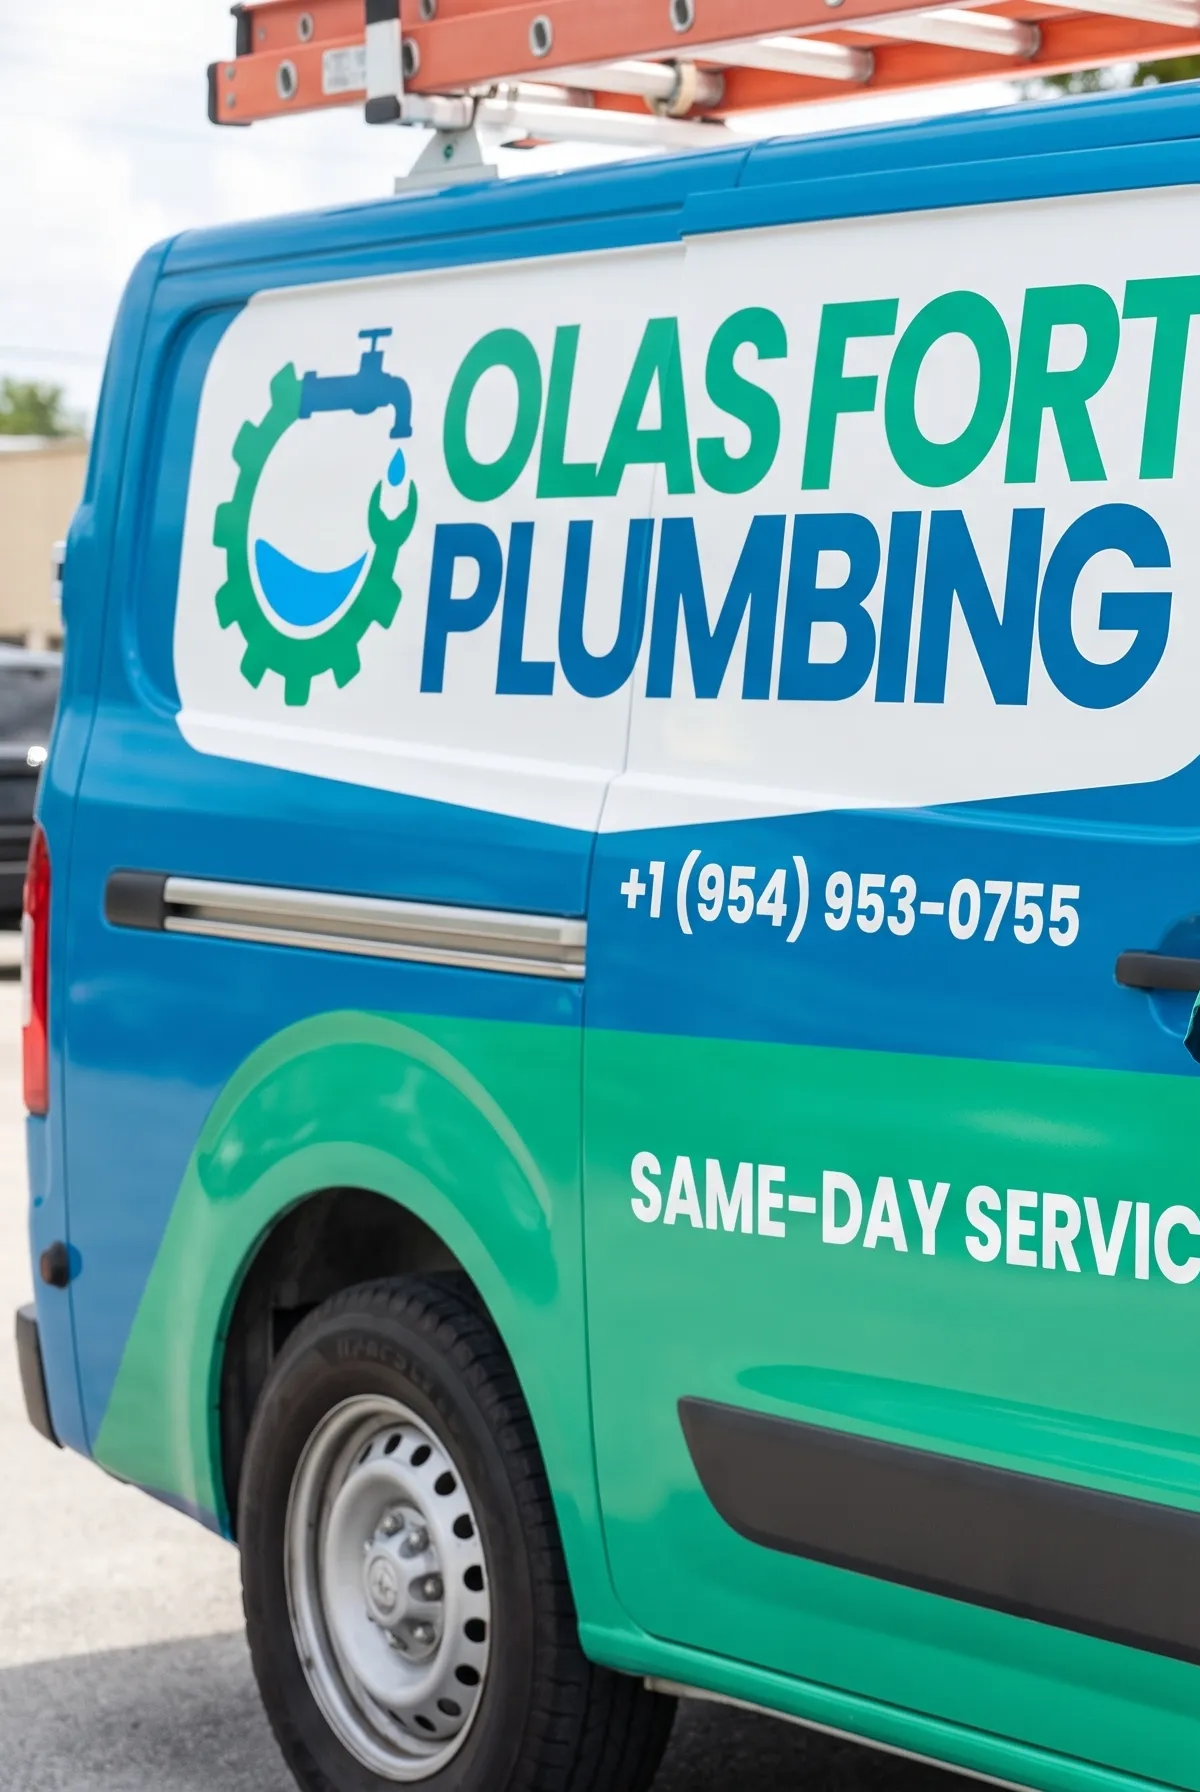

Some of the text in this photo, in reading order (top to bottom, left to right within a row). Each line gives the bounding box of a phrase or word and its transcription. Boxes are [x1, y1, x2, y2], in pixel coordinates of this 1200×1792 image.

[442, 307, 788, 503] OLAS
[420, 503, 1173, 710] PLUMBING
[620, 850, 1080, 947] +1 (954) 953-0755
[630, 1151, 950, 1255] SAME-DAY
